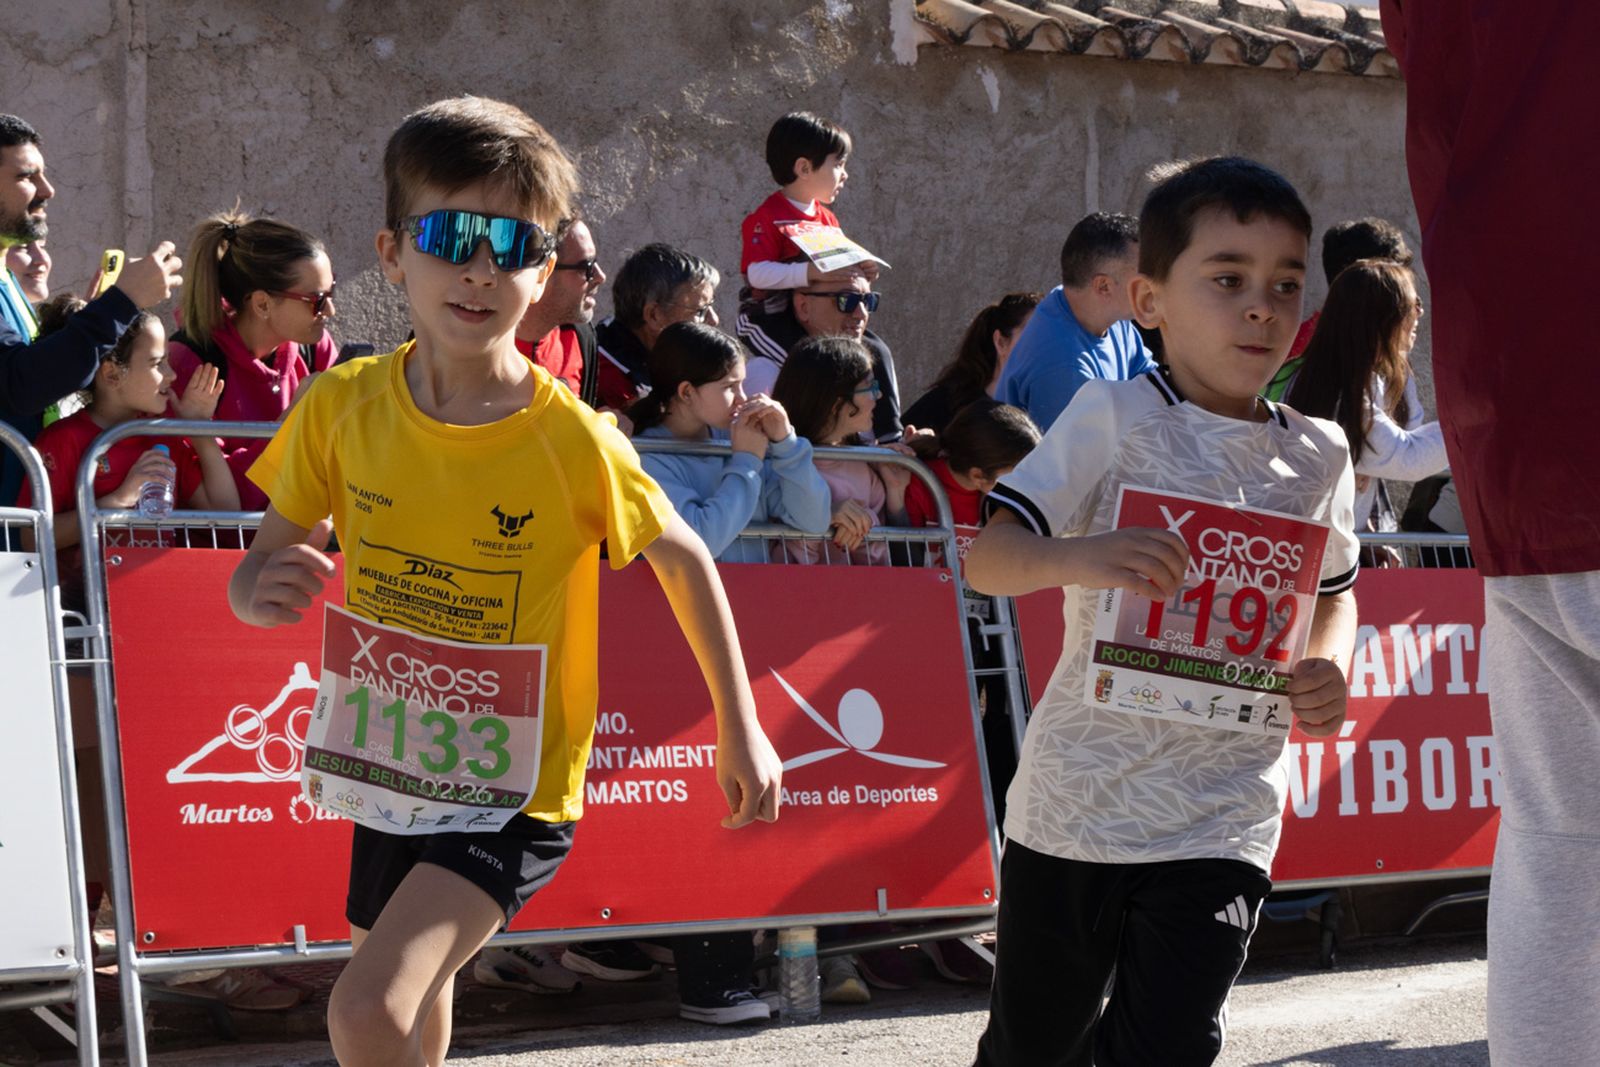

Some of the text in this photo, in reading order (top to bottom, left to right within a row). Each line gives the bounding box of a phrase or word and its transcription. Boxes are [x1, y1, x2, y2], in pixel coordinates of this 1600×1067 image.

[358, 489, 393, 508] ANTÓN
[471, 537, 534, 551] THREE BULLS
[1158, 504, 1196, 550] X
[1198, 527, 1304, 572] CROSS
[358, 566, 504, 609] MUEBLES DE COCINA y OFICINA
[1184, 555, 1281, 595] NTANO
[1282, 578, 1296, 592] DEL
[457, 610, 483, 620] VENTA
[1145, 577, 1298, 662] 1192
[1150, 639, 1221, 661] DE MARTOS
[1164, 629, 1223, 652] CASIAS
[351, 626, 381, 671] X
[386, 652, 500, 697] CROSS
[1101, 645, 1160, 669] ROCIO
[1350, 623, 1489, 698] ANT
[350, 664, 499, 719] PANTANO DEL
[345, 685, 511, 780] 1133
[594, 711, 635, 735] MO.
[309, 751, 365, 778] JESUS
[356, 747, 417, 776] DE MARTOS
[368, 740, 418, 765] CASIAS
[586, 744, 717, 769] UNTAMIENT
[1287, 720, 1501, 818] VÍBOR
[586, 779, 689, 805] MARTOS
[779, 784, 939, 808] Area de Deportes
[179, 803, 273, 825] Martos
[467, 844, 504, 872] KIPSTA
